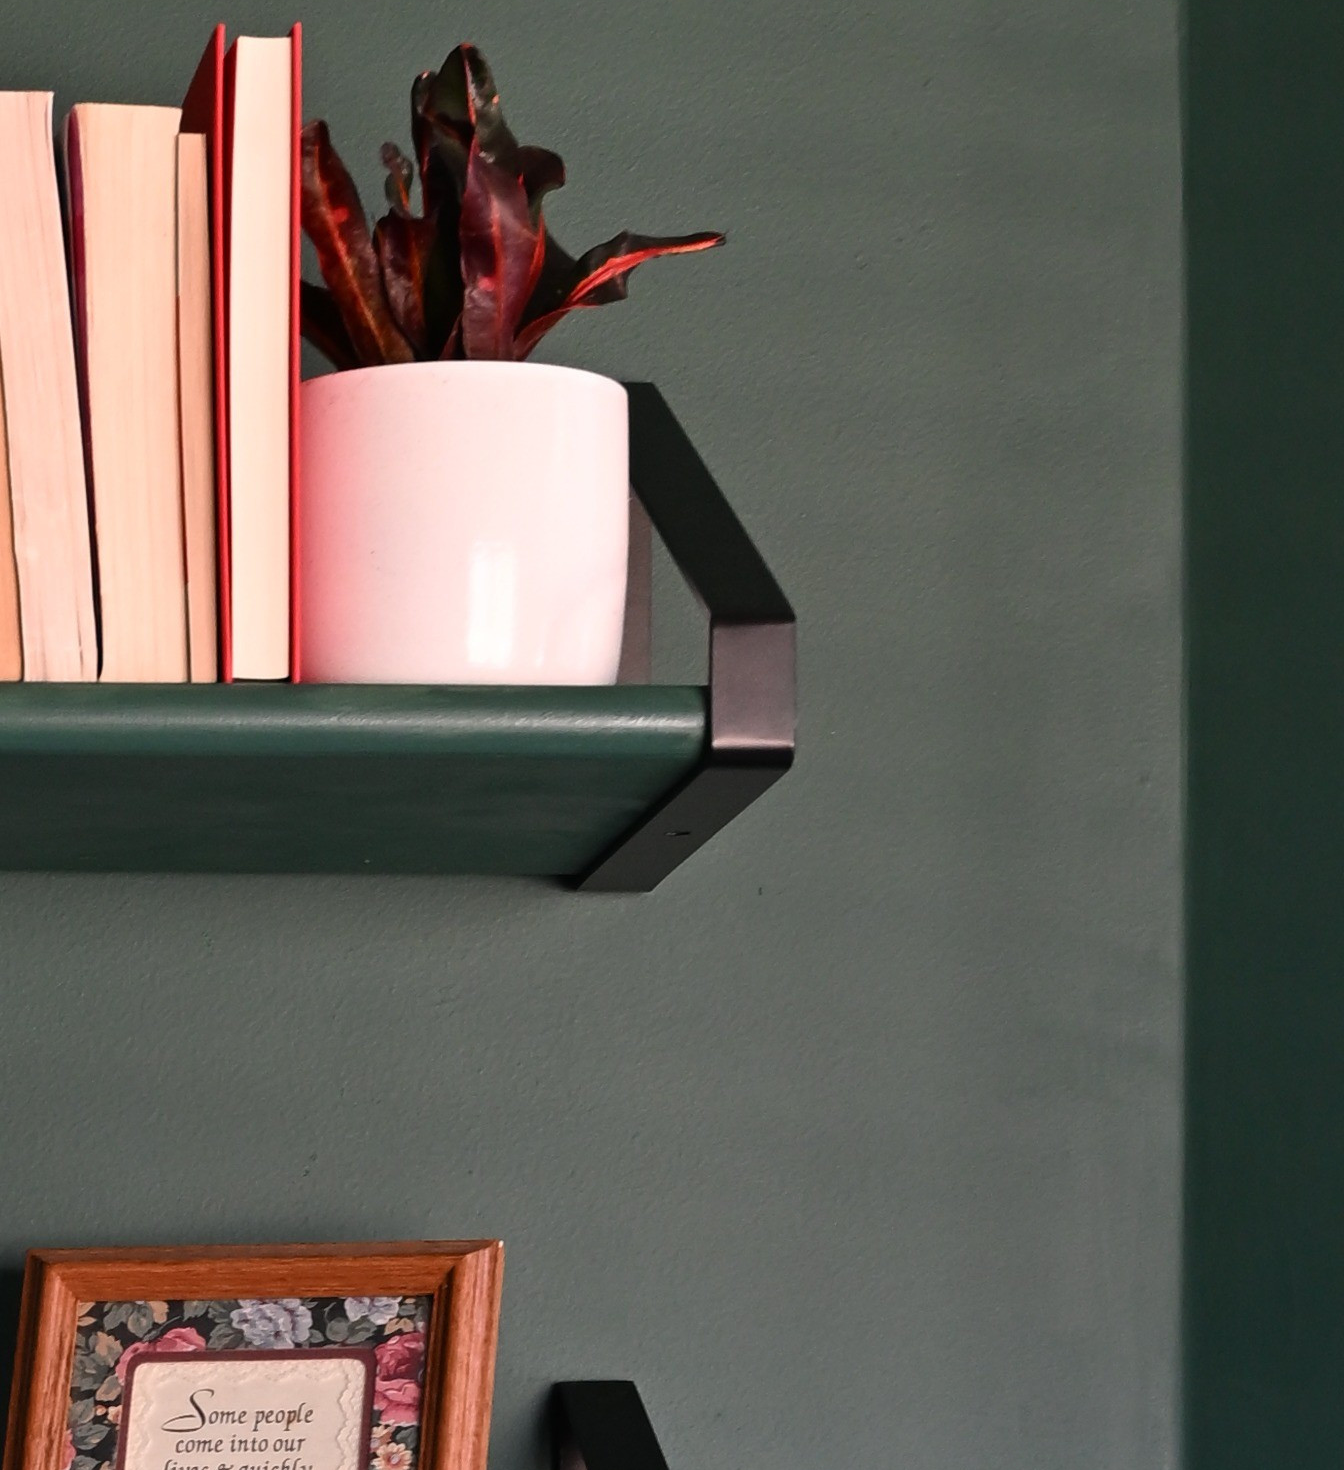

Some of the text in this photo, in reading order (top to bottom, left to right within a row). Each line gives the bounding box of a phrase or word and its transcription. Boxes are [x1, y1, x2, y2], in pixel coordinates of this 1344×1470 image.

[161, 1388, 314, 1433] Some people
[174, 1432, 307, 1454] come into our
